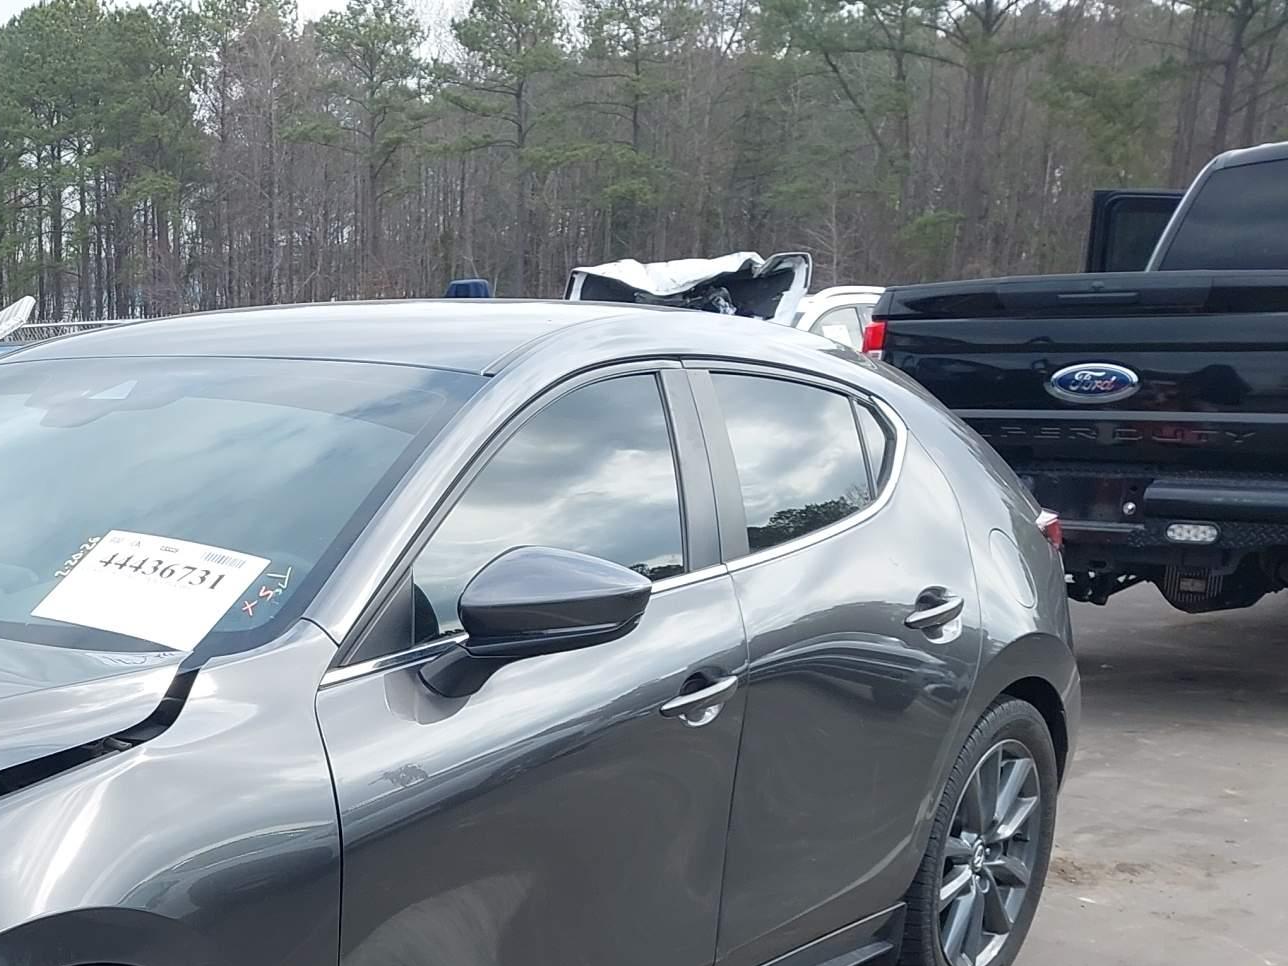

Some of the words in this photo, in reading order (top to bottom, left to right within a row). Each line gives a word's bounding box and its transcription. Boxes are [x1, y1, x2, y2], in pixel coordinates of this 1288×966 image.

[1068, 369, 1116, 392] Ford
[1114, 428, 1257, 444] DUTY
[99, 552, 227, 590] 44436731
